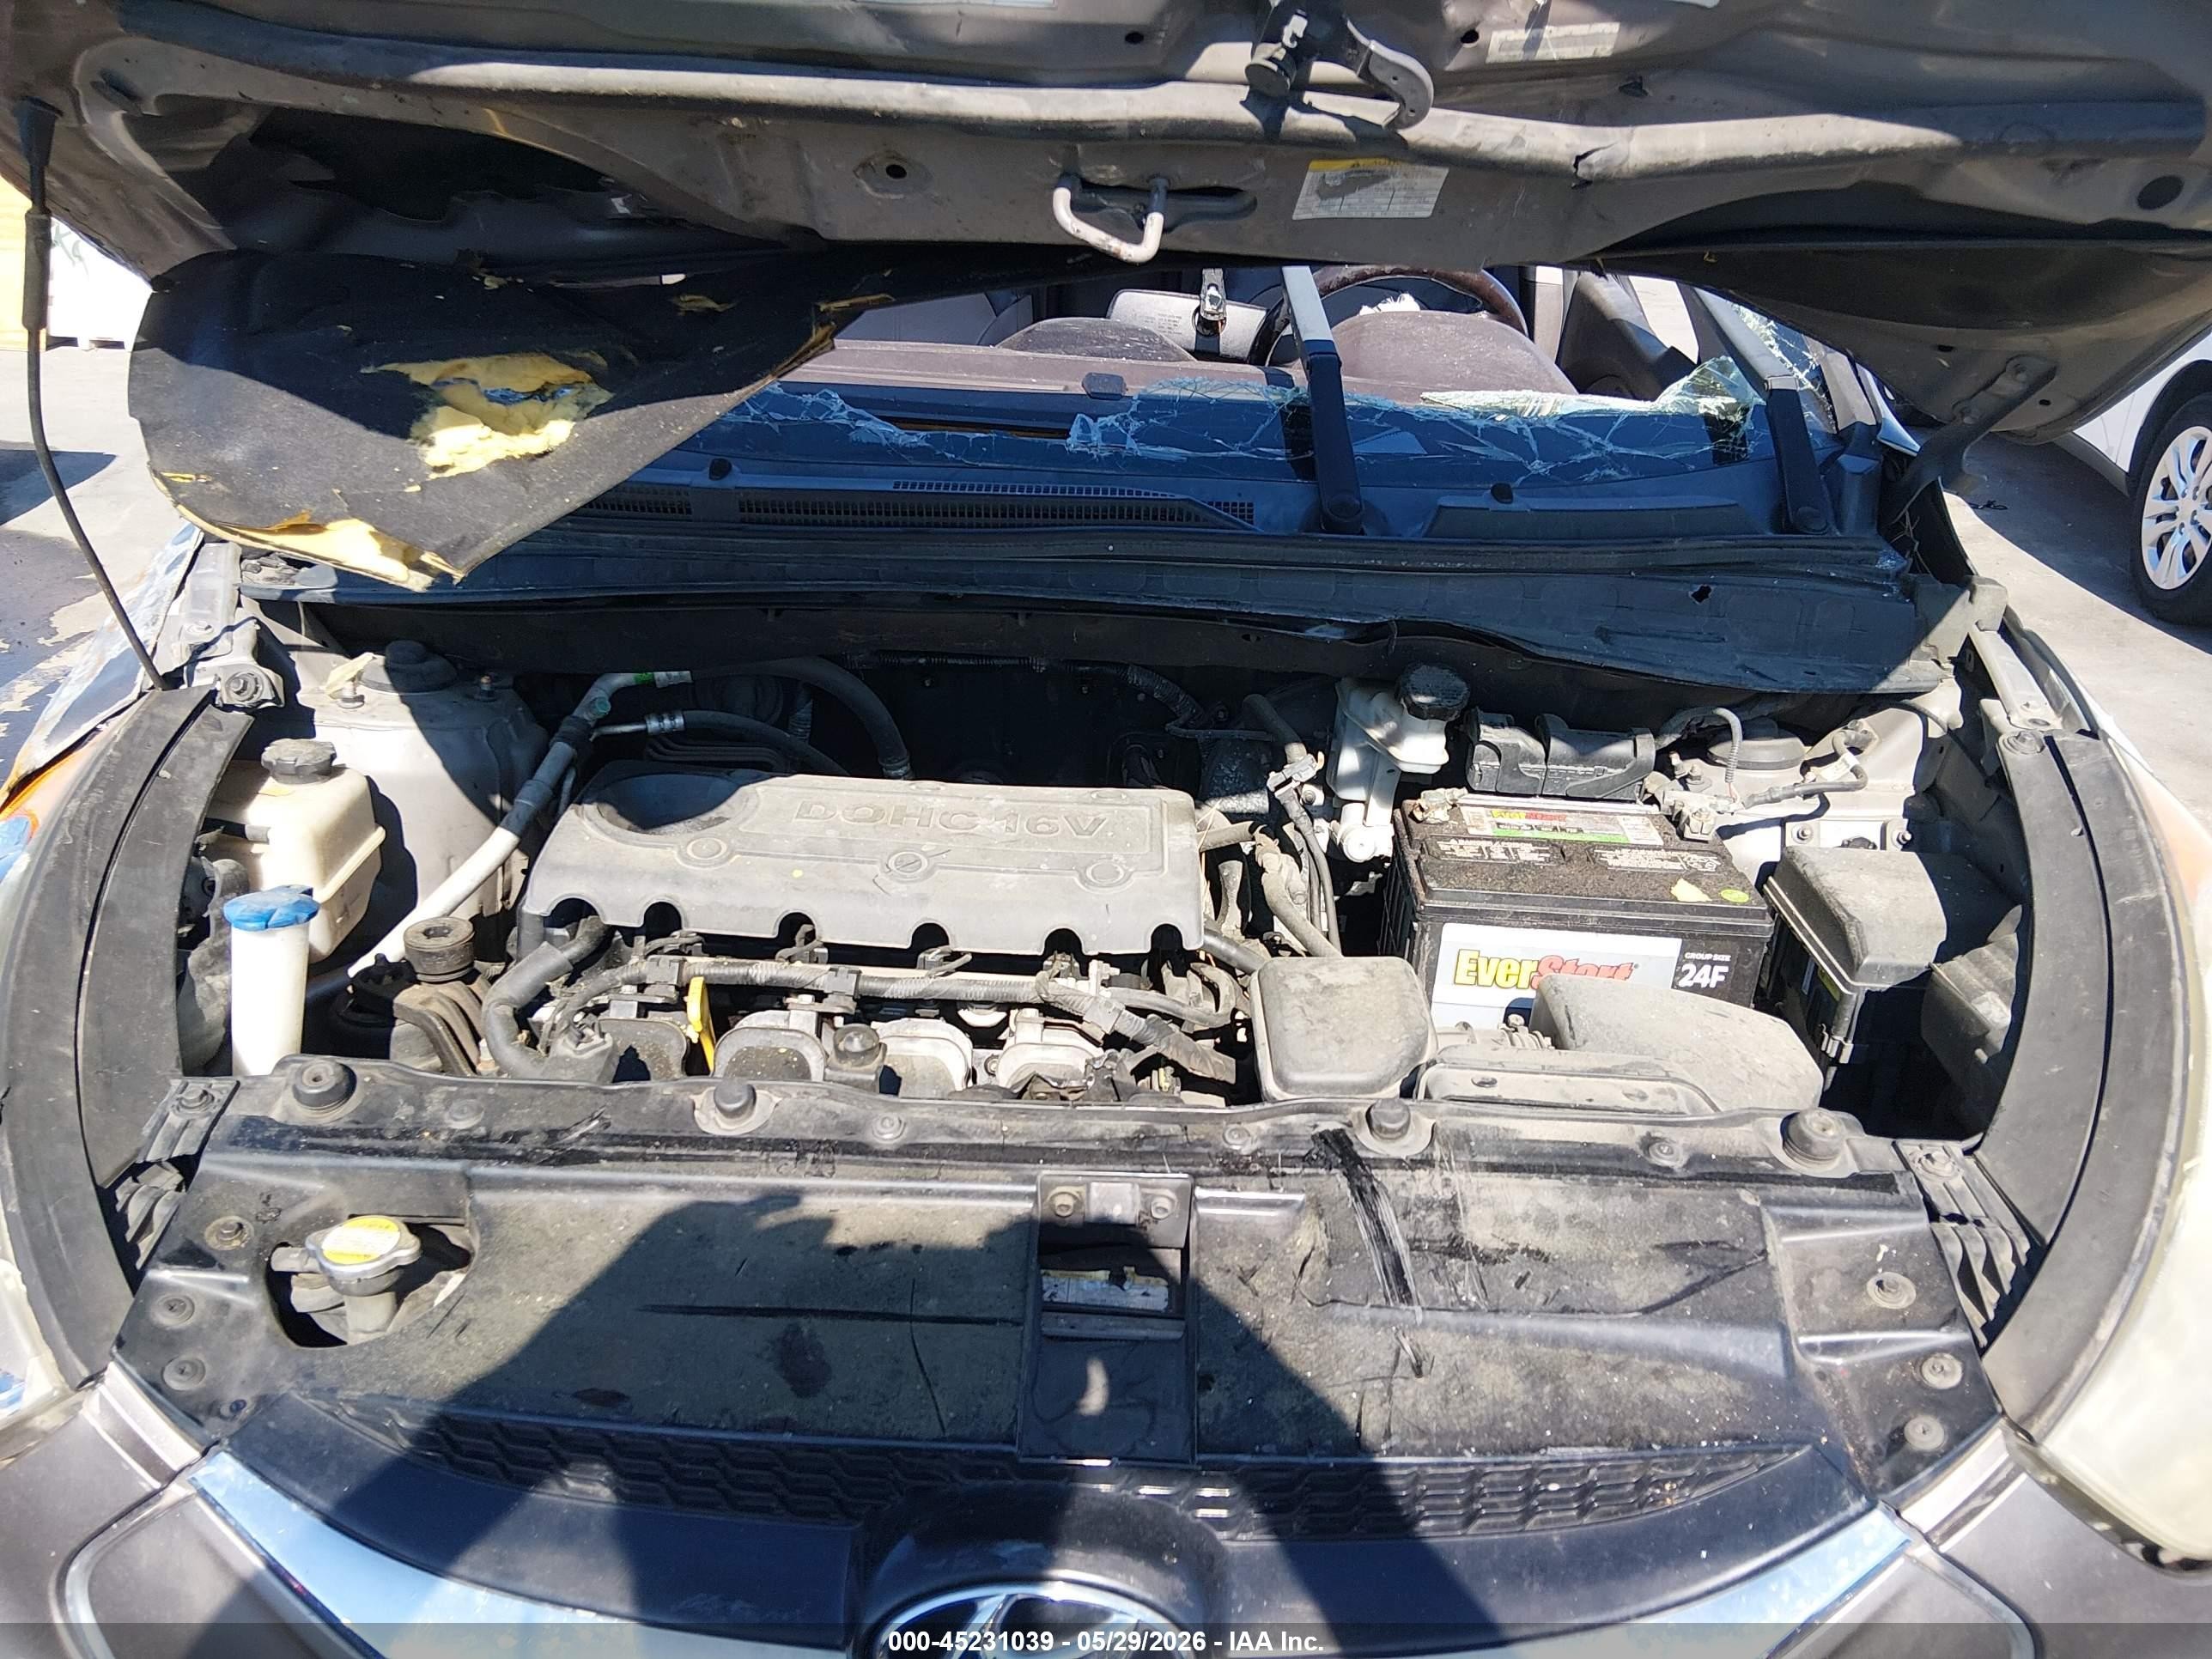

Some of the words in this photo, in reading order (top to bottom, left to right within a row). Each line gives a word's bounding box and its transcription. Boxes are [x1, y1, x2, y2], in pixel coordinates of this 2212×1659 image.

[793, 800, 979, 830] DOHC
[999, 813, 1108, 837] 16V
[1678, 963, 1729, 988] 24F
